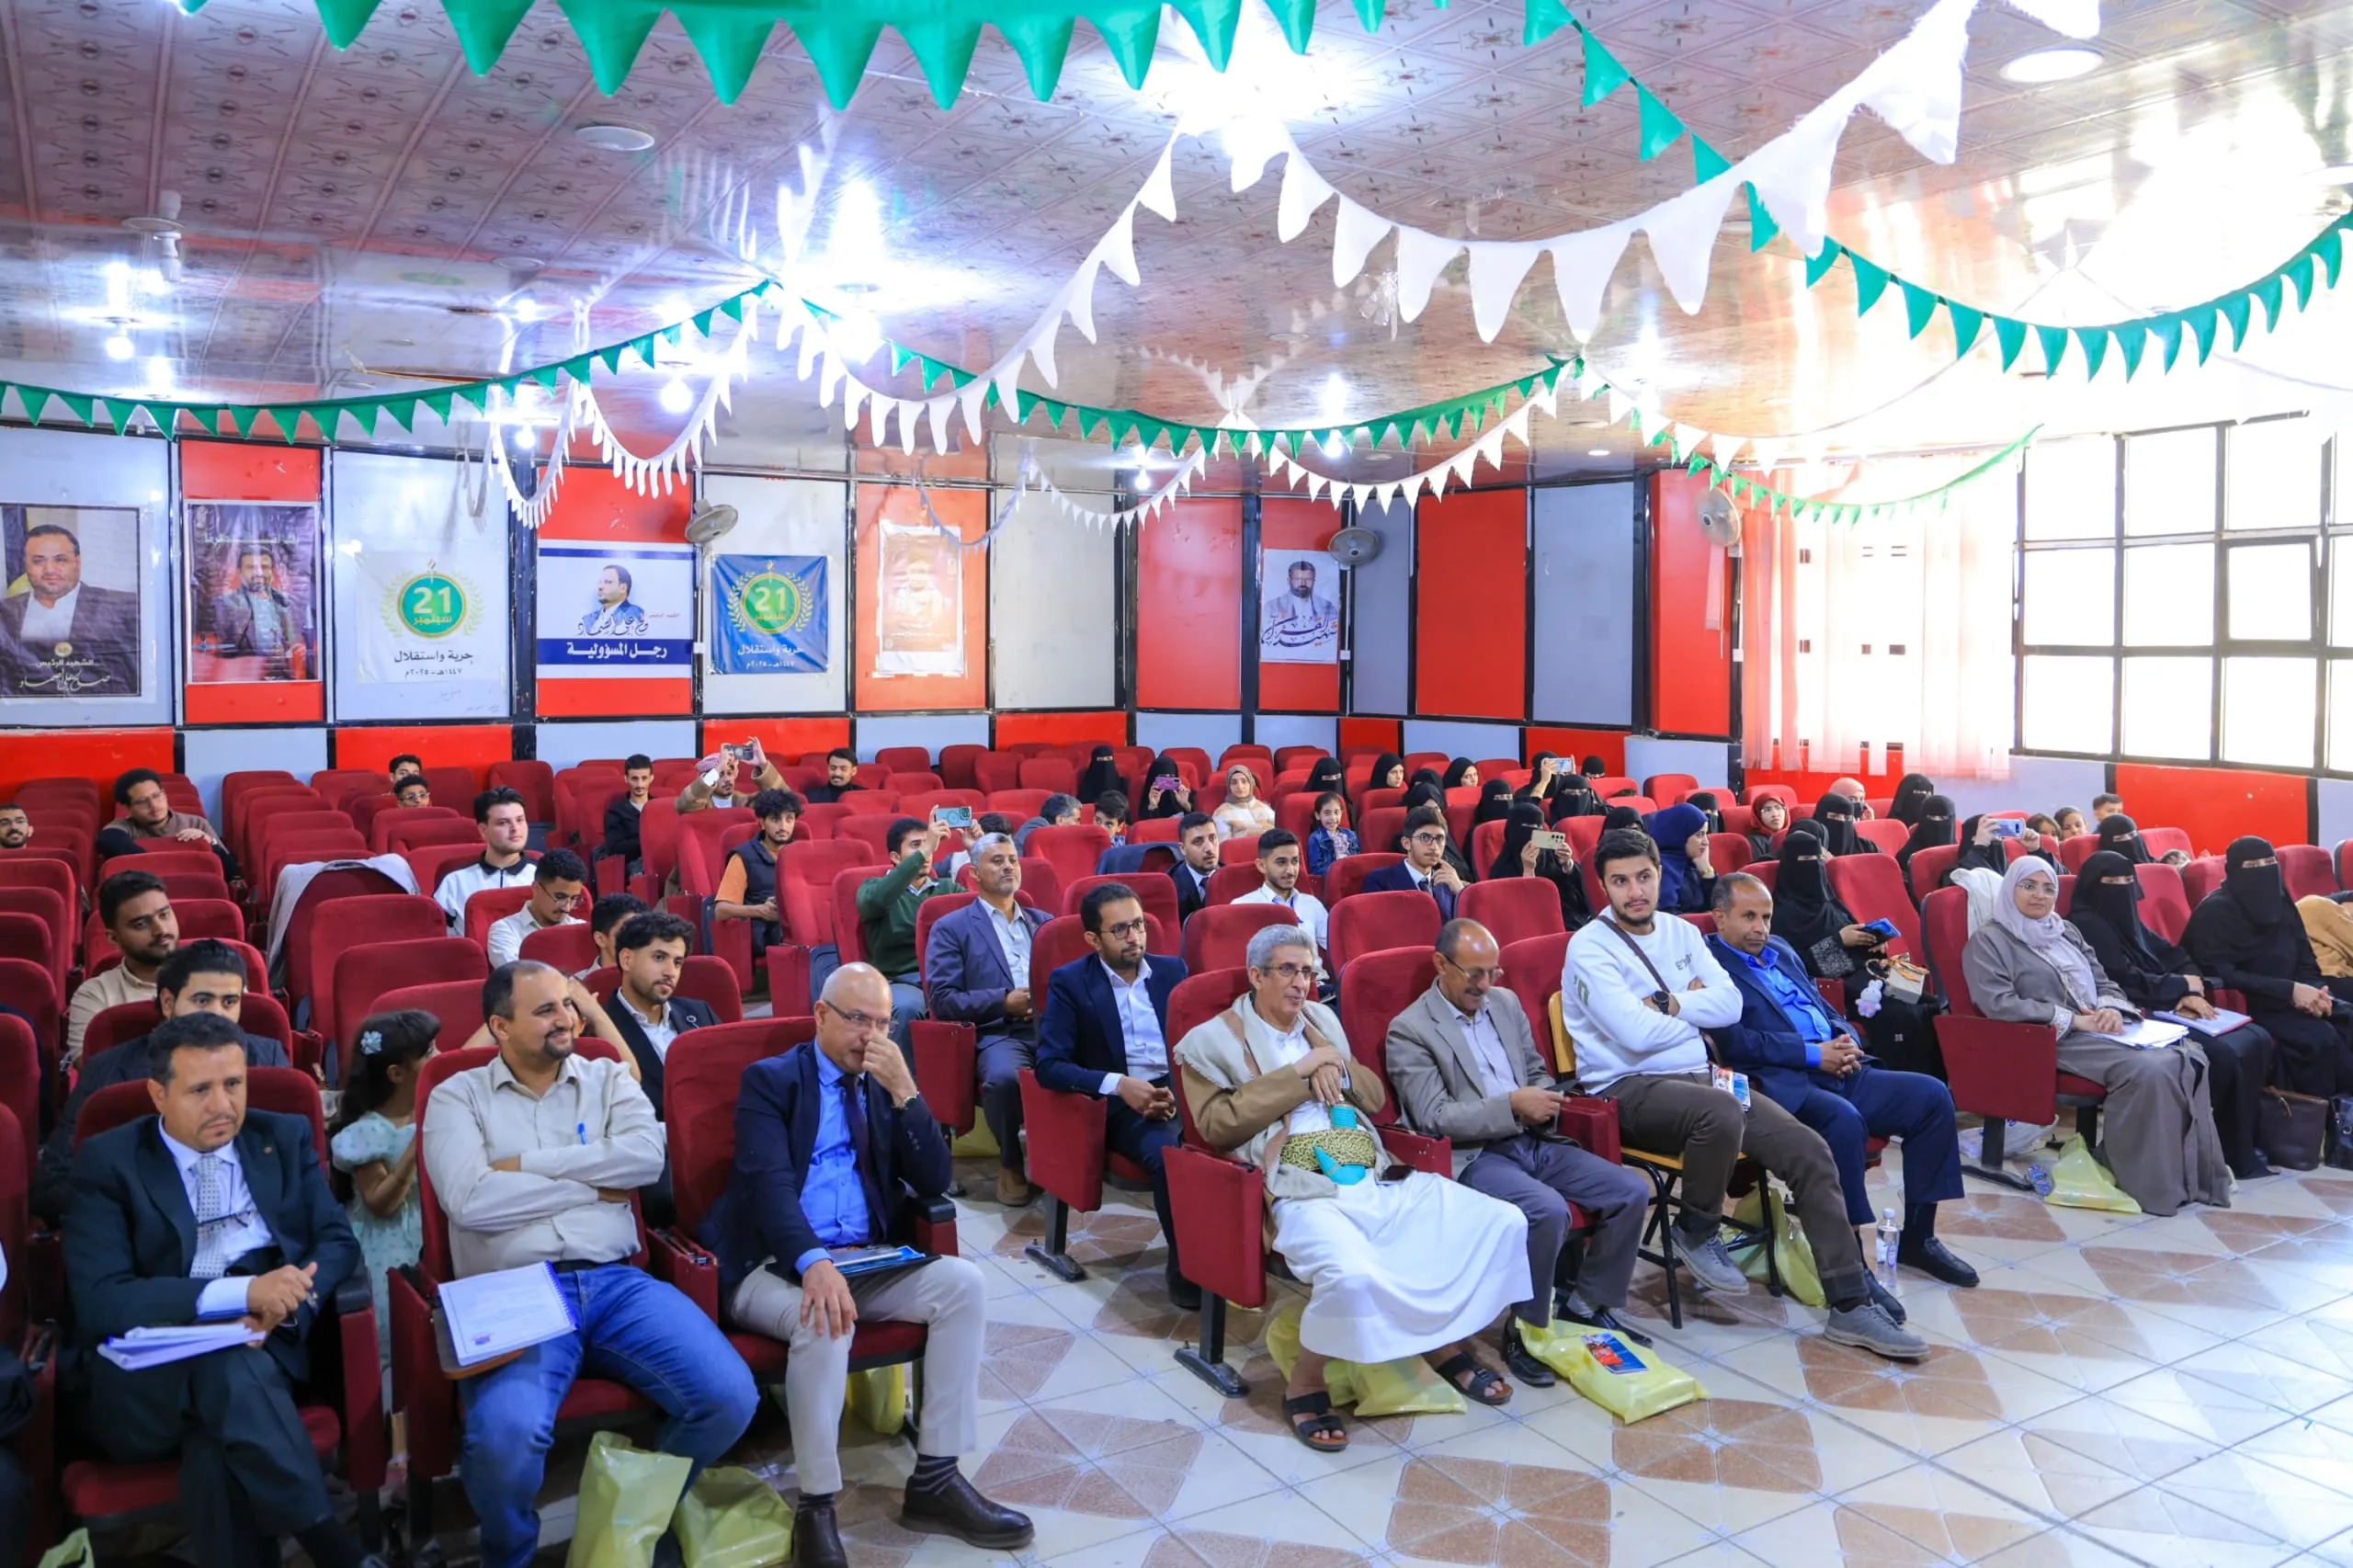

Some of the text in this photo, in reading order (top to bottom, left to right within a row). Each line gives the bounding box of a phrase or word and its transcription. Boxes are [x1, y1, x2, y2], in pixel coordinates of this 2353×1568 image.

[413, 586, 451, 614] 21
[755, 586, 786, 611] 21
[393, 650, 473, 663] حرية واستقلال
[566, 642, 667, 659] رجل المسؤولية
[737, 643, 804, 656] حرية واستقلال
